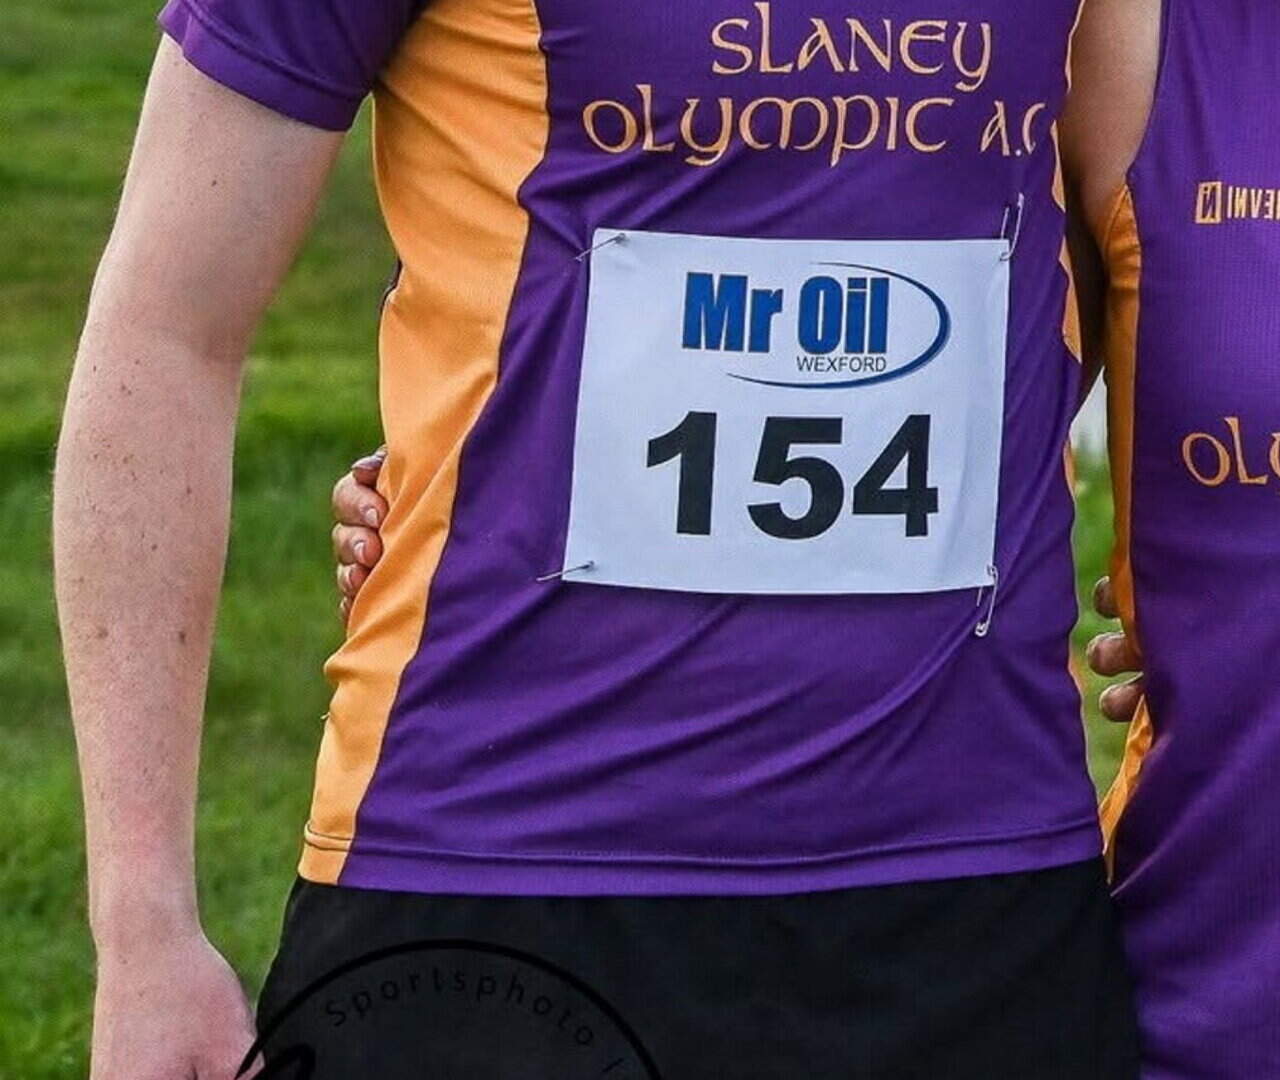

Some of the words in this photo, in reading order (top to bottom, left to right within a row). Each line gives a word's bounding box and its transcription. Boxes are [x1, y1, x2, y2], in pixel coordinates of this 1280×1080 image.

[711, 2, 991, 91] SLANEY
[583, 84, 954, 167] OLYMPIC
[682, 271, 783, 353] Mr
[798, 275, 890, 354] Oil
[796, 355, 887, 373] WEXFORD
[646, 411, 938, 540] 154
